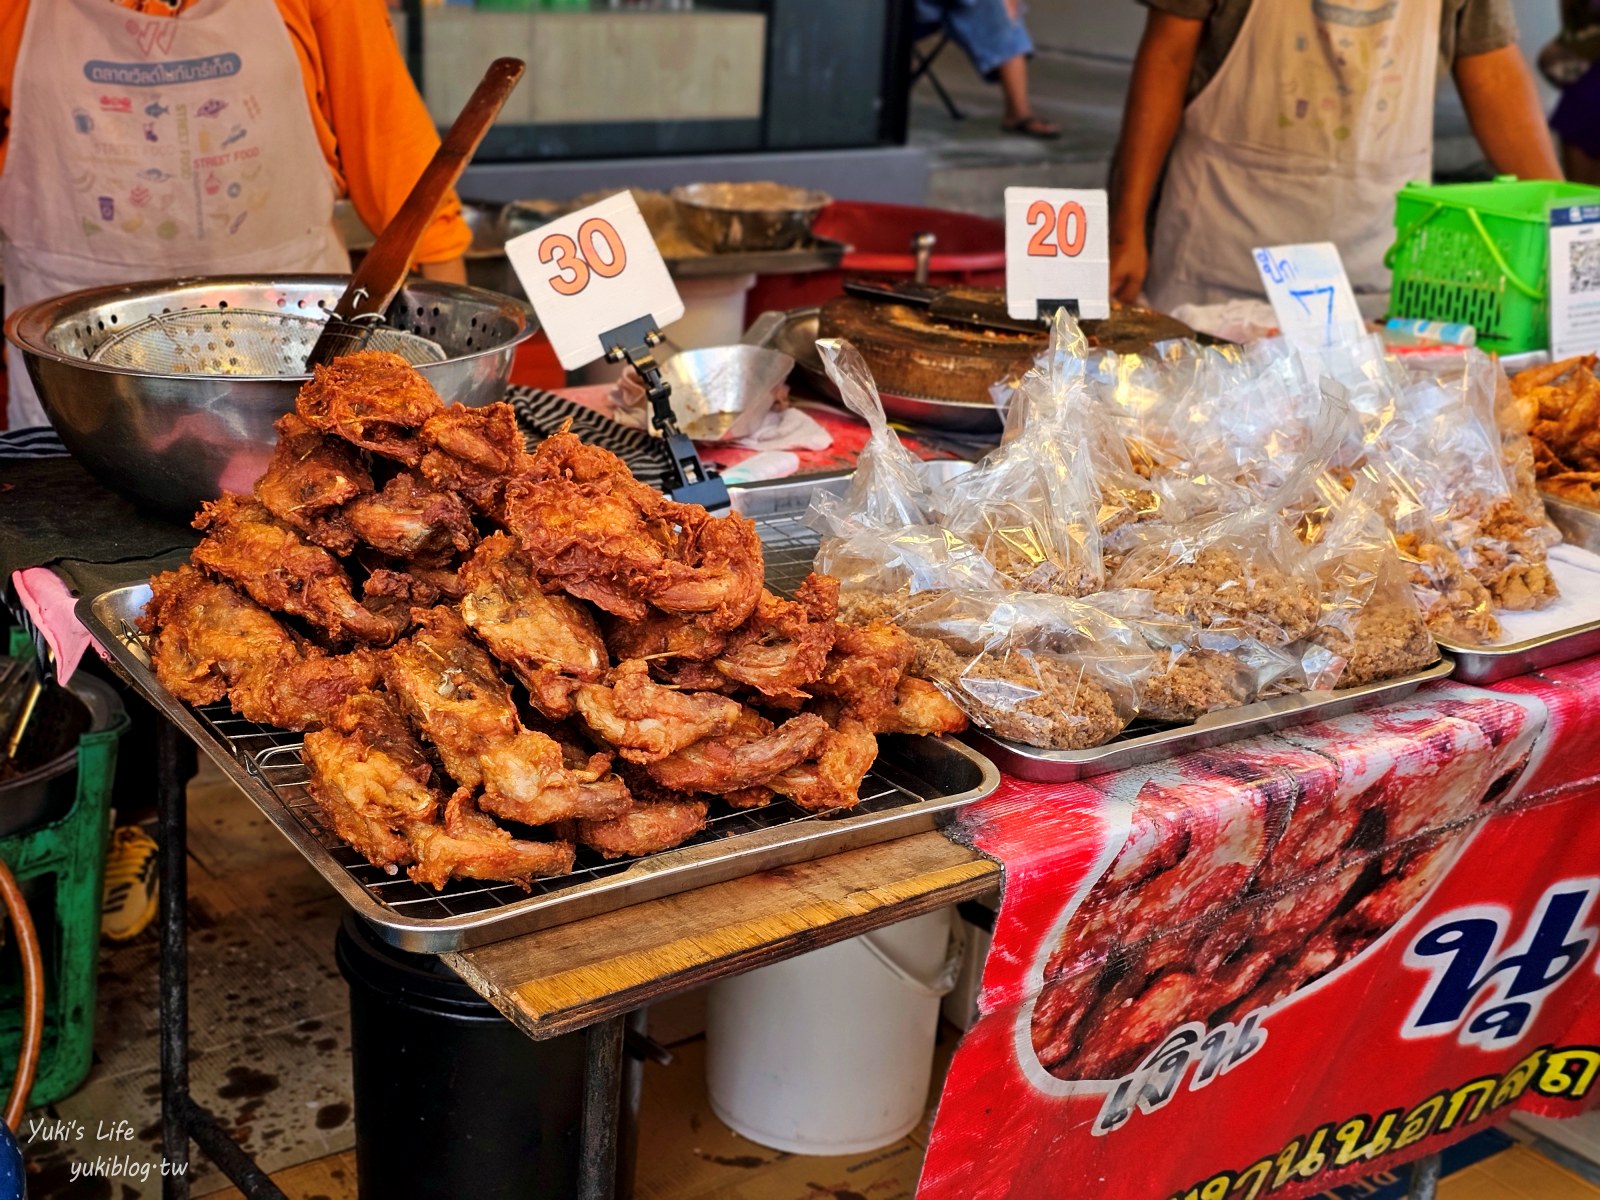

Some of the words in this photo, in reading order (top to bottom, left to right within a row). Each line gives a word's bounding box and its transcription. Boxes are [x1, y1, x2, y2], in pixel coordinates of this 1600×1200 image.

[193, 154, 231, 169] STREET
[233, 147, 260, 162] FOOD
[538, 217, 628, 296] 30
[1026, 200, 1088, 258] 20
[1288, 285, 1335, 347] 7
